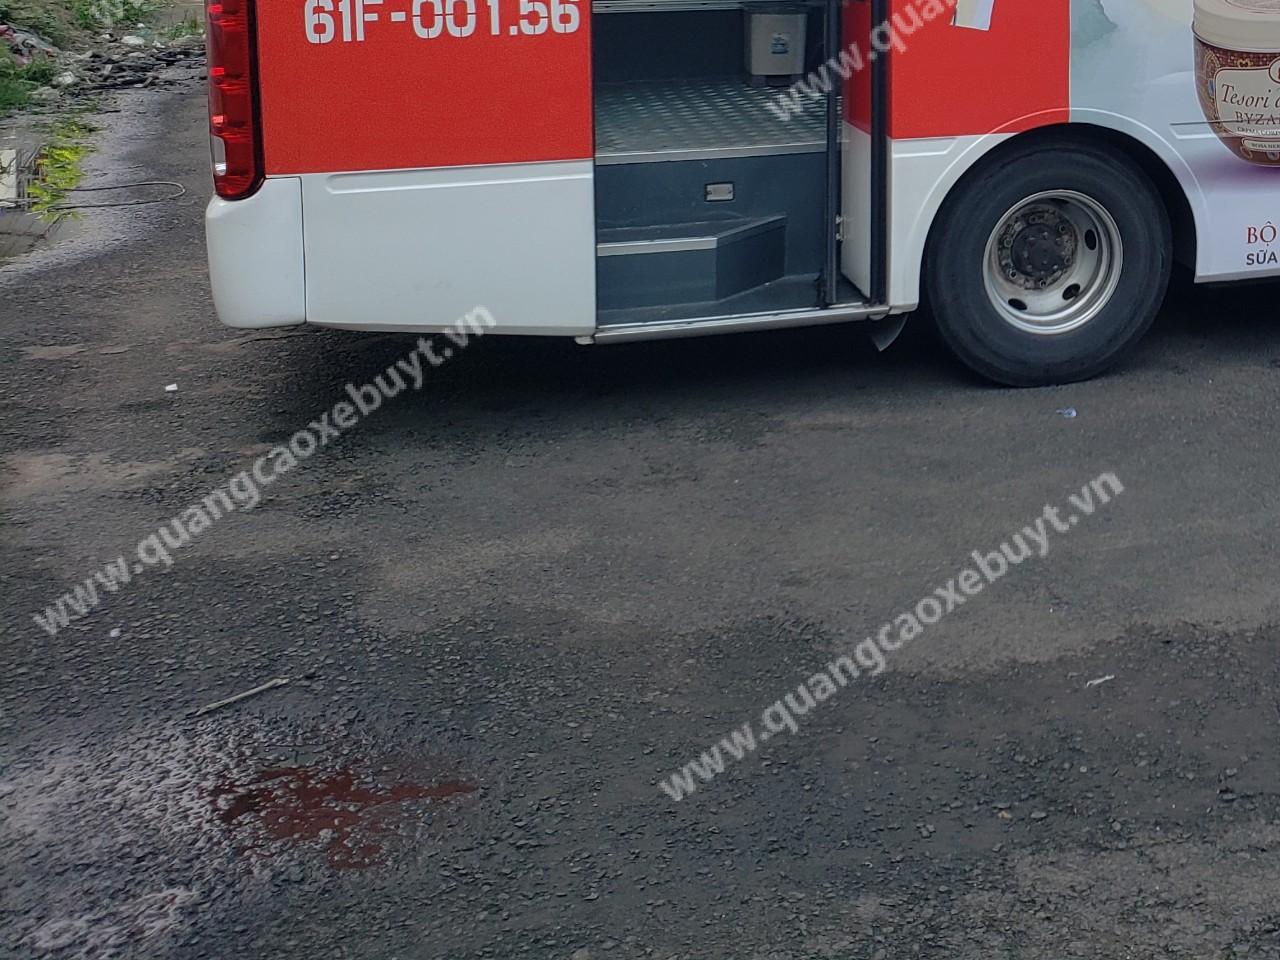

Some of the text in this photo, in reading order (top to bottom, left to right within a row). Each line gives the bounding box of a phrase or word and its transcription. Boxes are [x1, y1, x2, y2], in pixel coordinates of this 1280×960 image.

[1221, 83, 1272, 108] Tesori
[1246, 220, 1277, 245] BỘ
[1246, 248, 1278, 266] SỮA
